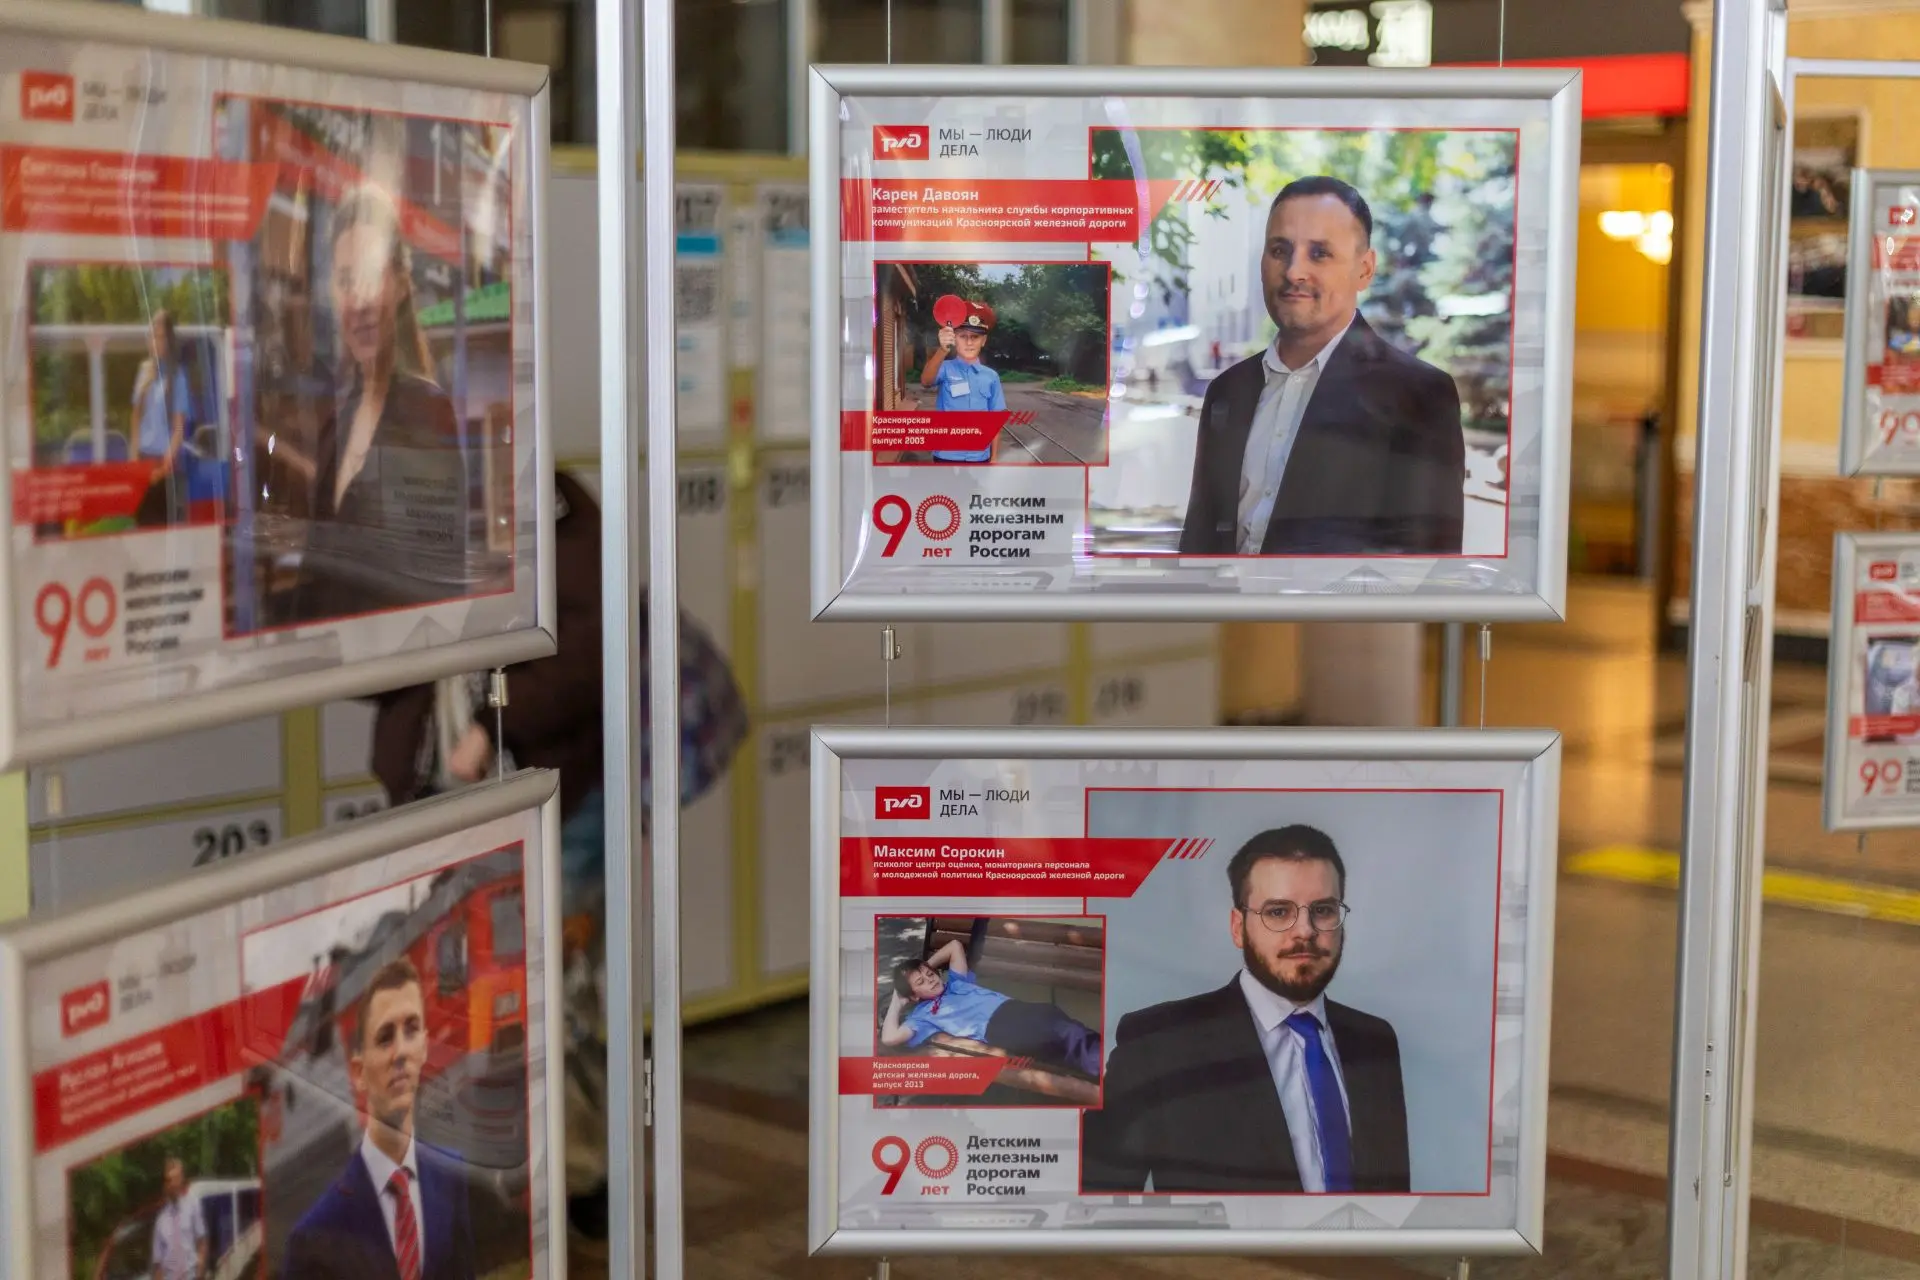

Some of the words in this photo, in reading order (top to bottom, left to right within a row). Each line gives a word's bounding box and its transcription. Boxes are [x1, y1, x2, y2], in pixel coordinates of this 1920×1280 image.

[938, 128, 965, 141] МЫ
[985, 128, 1032, 143] ЛЮДИ
[939, 144, 979, 158] ДЕЛА
[872, 187, 917, 204] Карен
[922, 188, 979, 202] Давоян
[872, 205, 939, 215] заместитель
[941, 205, 1004, 215] начальника
[1006, 205, 1048, 218] службы
[1051, 206, 1134, 218] корпоративных
[872, 217, 953, 229] коммуникаций
[956, 217, 1031, 230] Красноярской
[1033, 218, 1086, 229] железной
[1088, 220, 1127, 230] дороги
[872, 416, 931, 426] Красноярская
[872, 428, 906, 436] детская
[907, 428, 949, 436] железная
[950, 428, 983, 437] дорога,
[872, 438, 903, 446] выпуск
[904, 437, 925, 445] 2003
[968, 494, 1046, 510] Детским
[968, 513, 1064, 525] железным
[871, 494, 962, 558] 90
[968, 529, 1046, 543] дорогам
[922, 546, 953, 558] лет
[969, 545, 1031, 558] России
[34, 575, 118, 669] 90
[939, 789, 965, 801] МЫ
[985, 789, 1030, 804] ЛЮДИ
[939, 804, 978, 817] ДЕЛА
[874, 844, 936, 858] Максим
[940, 844, 1005, 860] Сорокин
[873, 860, 912, 869] психолог
[915, 861, 946, 870] центра
[947, 861, 983, 870] оценки,
[984, 862, 1043, 870] мониторинга
[1044, 862, 1090, 870] персонала
[881, 871, 938, 880] молодежной
[940, 871, 983, 880] политики
[985, 871, 1047, 880] Красноярской
[1049, 871, 1092, 880] железной
[1093, 873, 1125, 881] дороги
[872, 1061, 930, 1071] Красноярская
[872, 1071, 905, 1080] детская
[906, 1071, 948, 1080] железная
[948, 1071, 980, 1081] дорога,
[872, 1081, 902, 1090] выпуск
[904, 1080, 924, 1089] 2013
[966, 1135, 1042, 1150] Детским
[966, 1152, 1059, 1164] железным
[871, 1135, 960, 1196] 90
[966, 1168, 1041, 1182] дорогам
[920, 1184, 950, 1196] лет
[966, 1183, 1027, 1196] России
